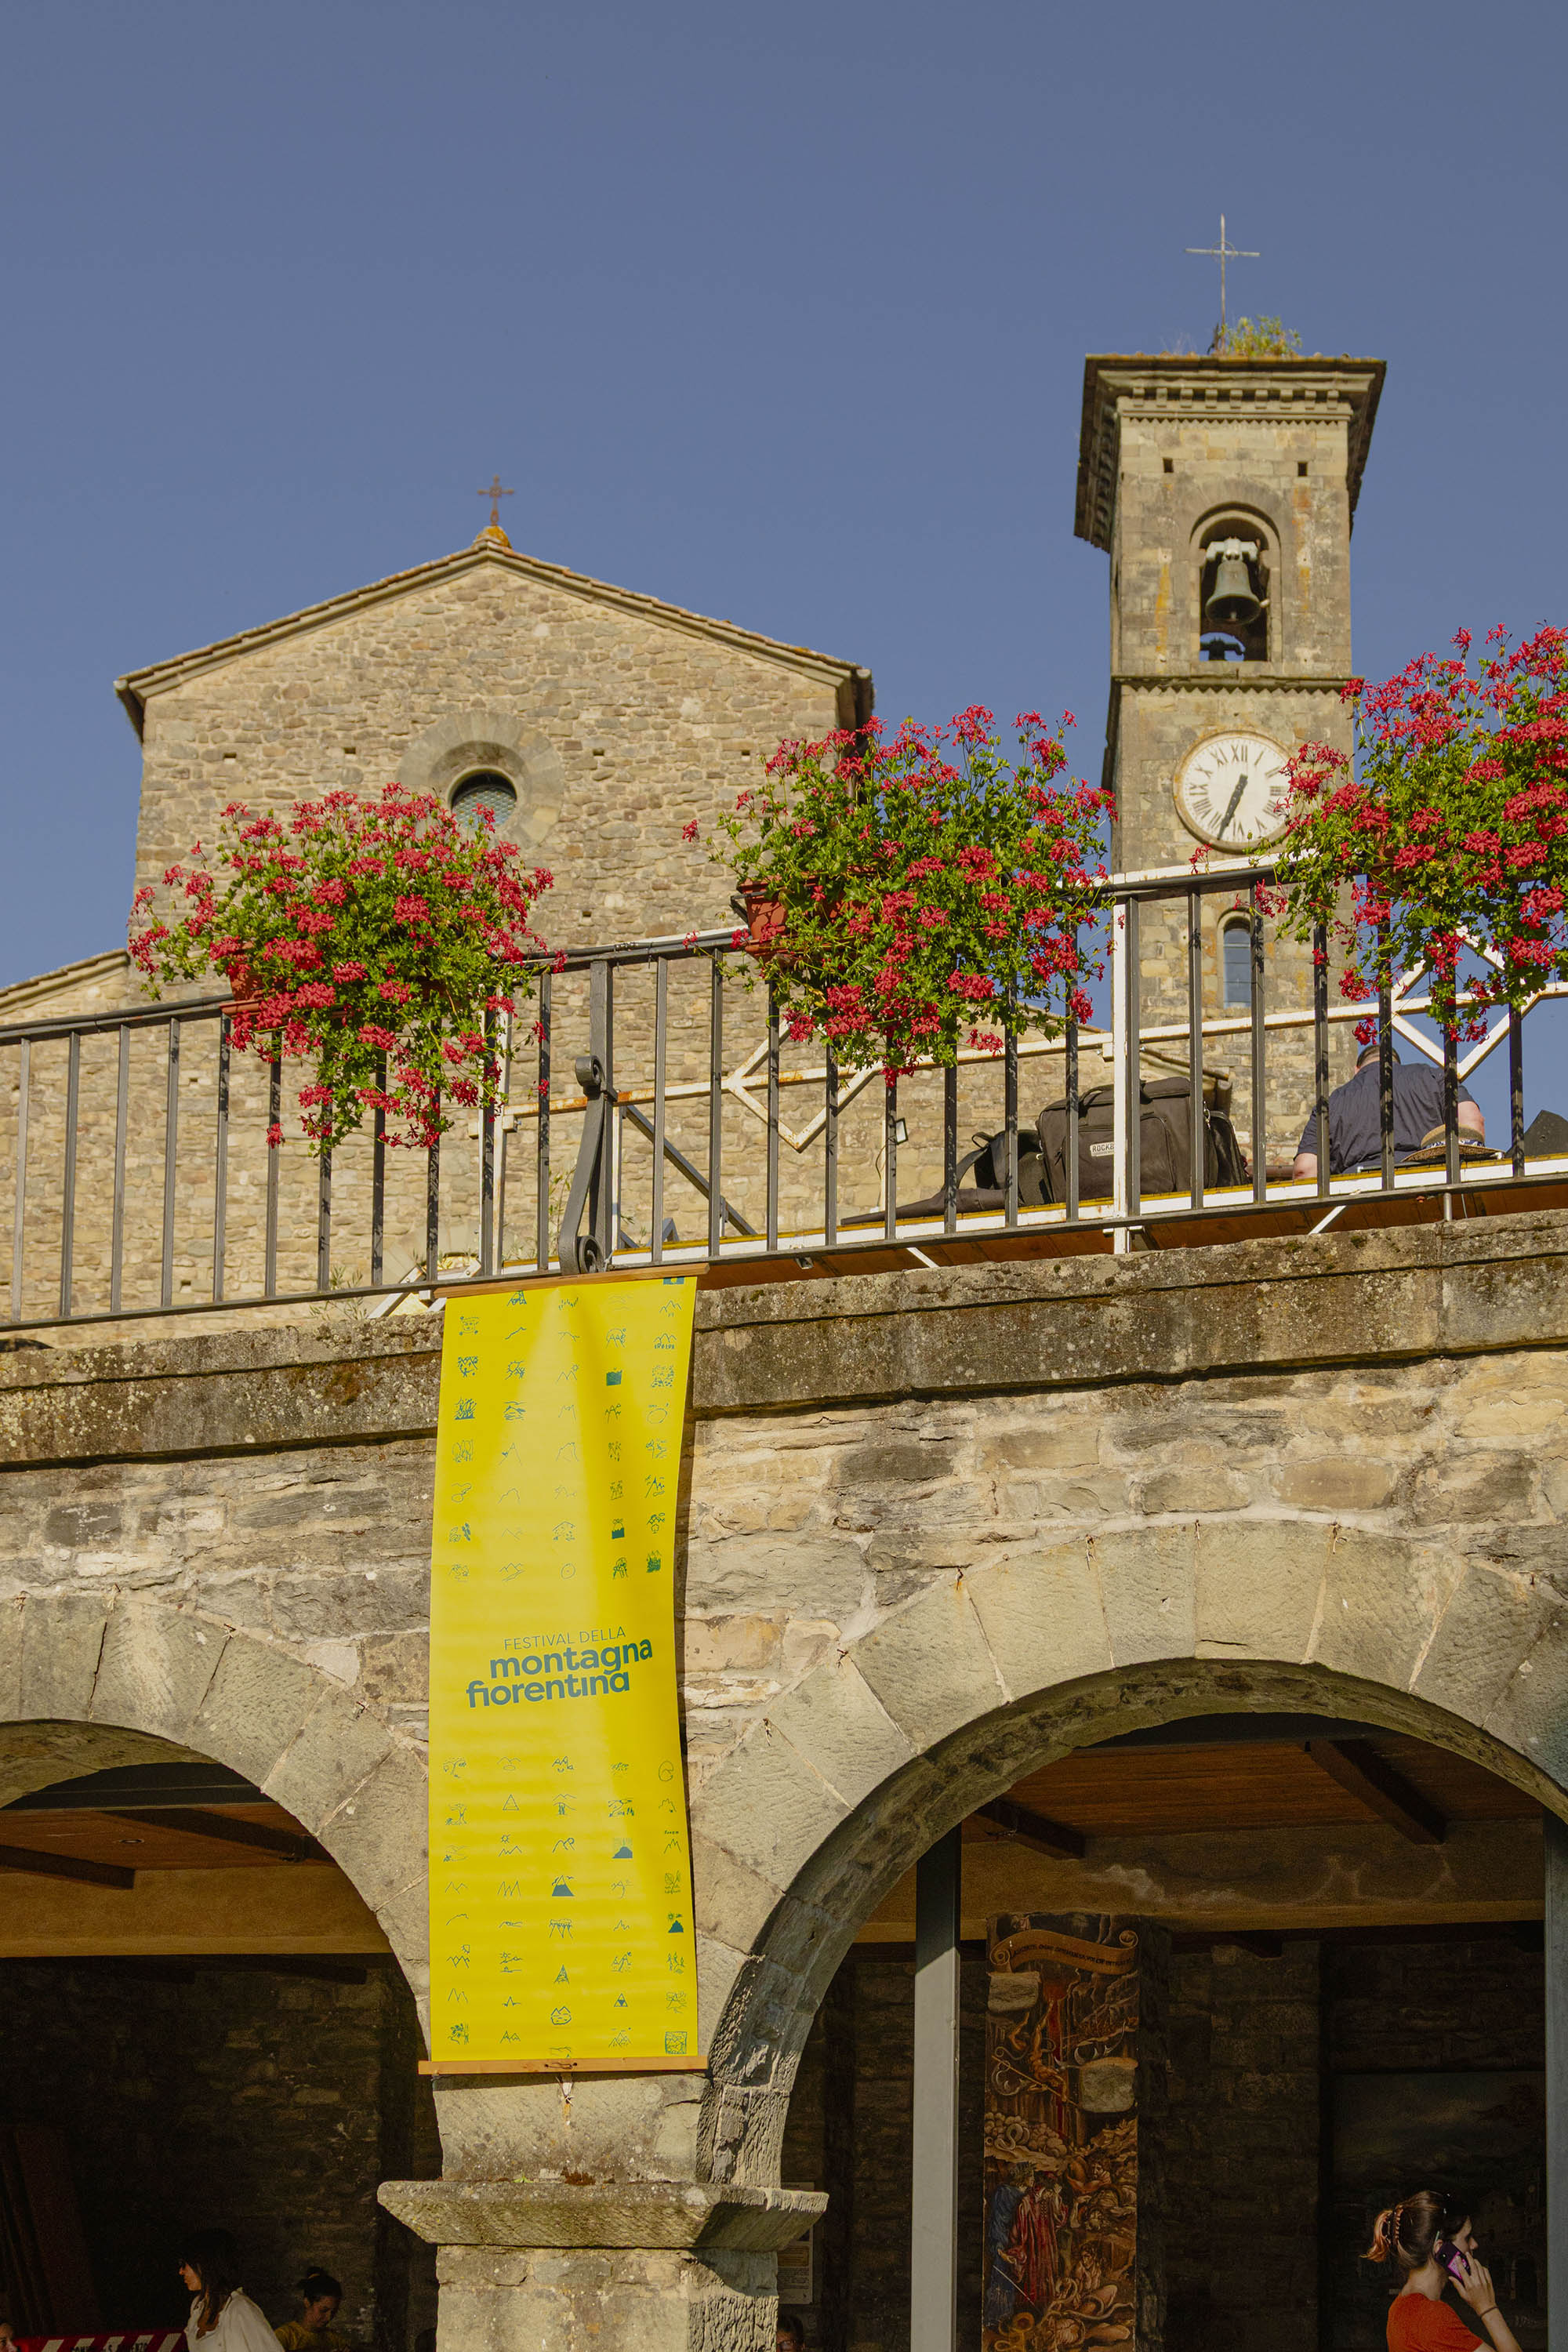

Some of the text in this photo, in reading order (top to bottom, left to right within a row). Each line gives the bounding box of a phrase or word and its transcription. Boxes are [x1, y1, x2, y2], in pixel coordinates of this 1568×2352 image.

[1231, 744, 1248, 763] XII
[503, 1625, 626, 1650] FESTIVAL DELLA
[490, 1638, 653, 1679] montagna
[466, 1669, 630, 1708] fiorentina
